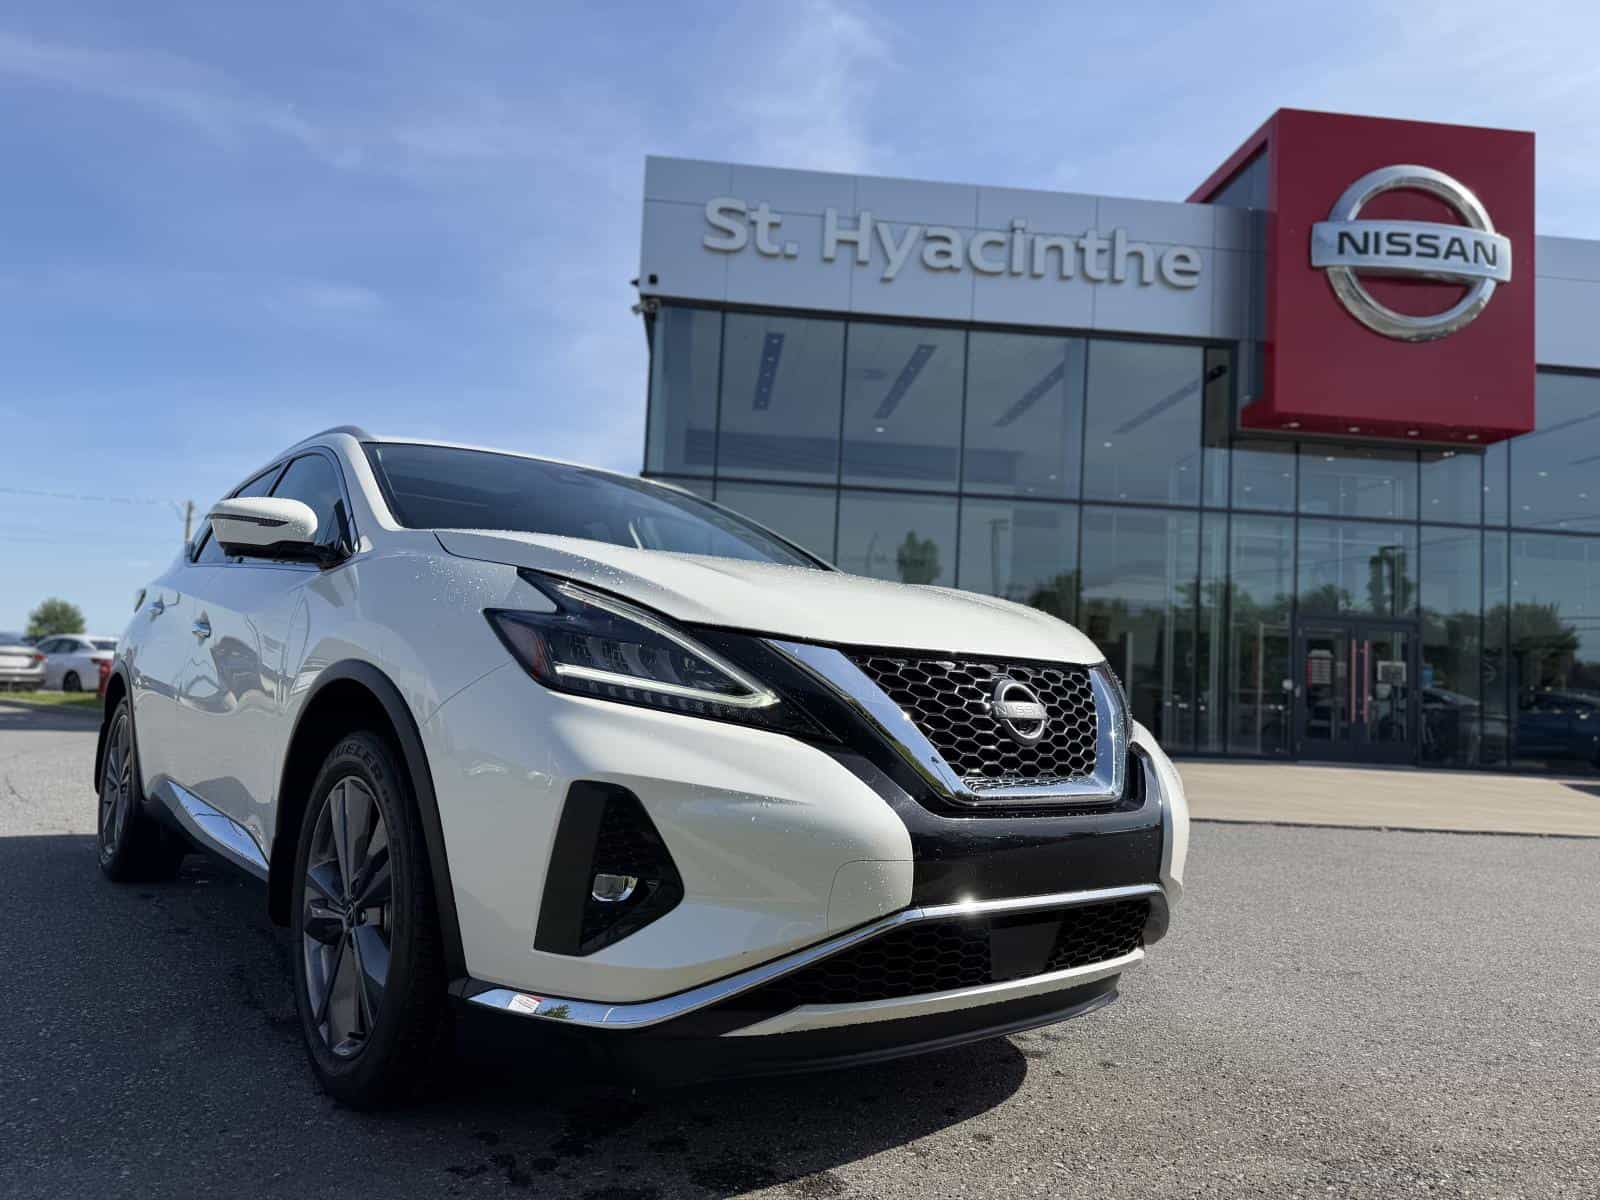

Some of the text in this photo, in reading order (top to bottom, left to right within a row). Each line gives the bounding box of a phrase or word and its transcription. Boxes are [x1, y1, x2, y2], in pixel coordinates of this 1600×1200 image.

[703, 198, 1201, 289] St. Hyacinthe
[1337, 231, 1497, 267] NISSAN
[994, 704, 1044, 717] NISS
